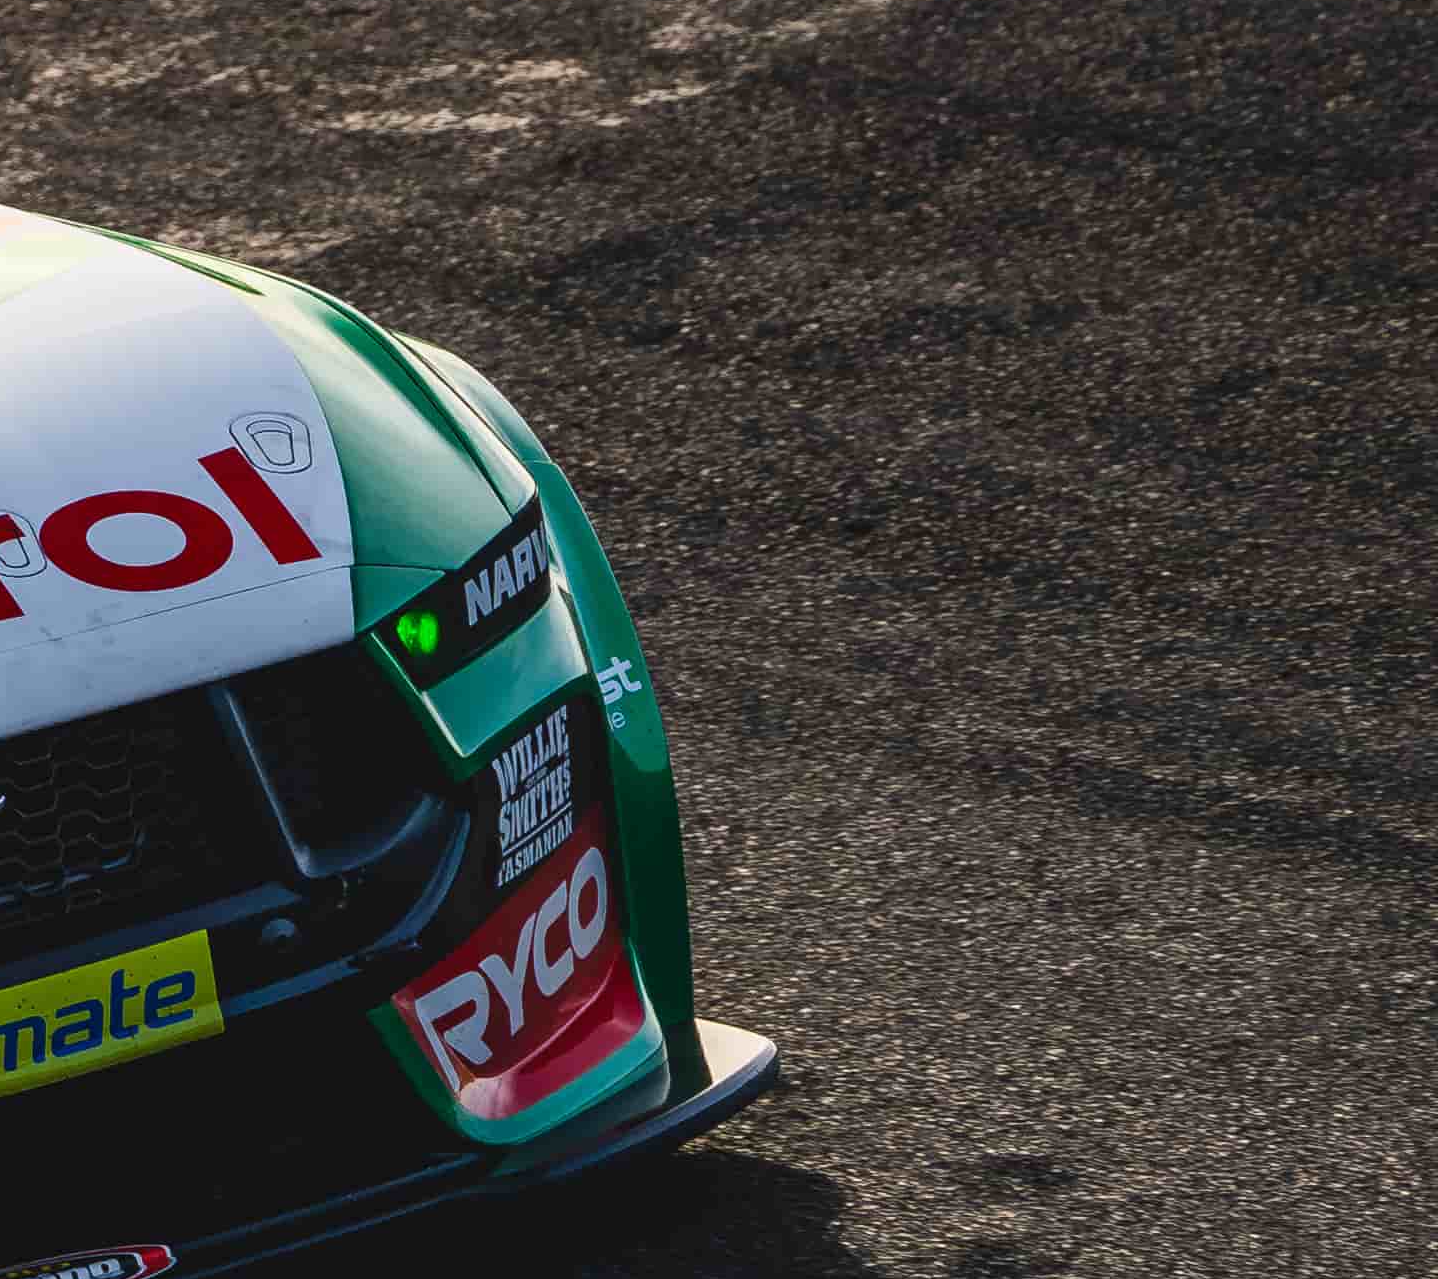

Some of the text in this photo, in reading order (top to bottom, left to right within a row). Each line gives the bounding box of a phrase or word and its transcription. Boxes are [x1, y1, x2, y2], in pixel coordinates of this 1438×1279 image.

[491, 704, 570, 802] WILLIE
[497, 810, 574, 888] TASMANIAN
[414, 846, 608, 1094] RYCO
